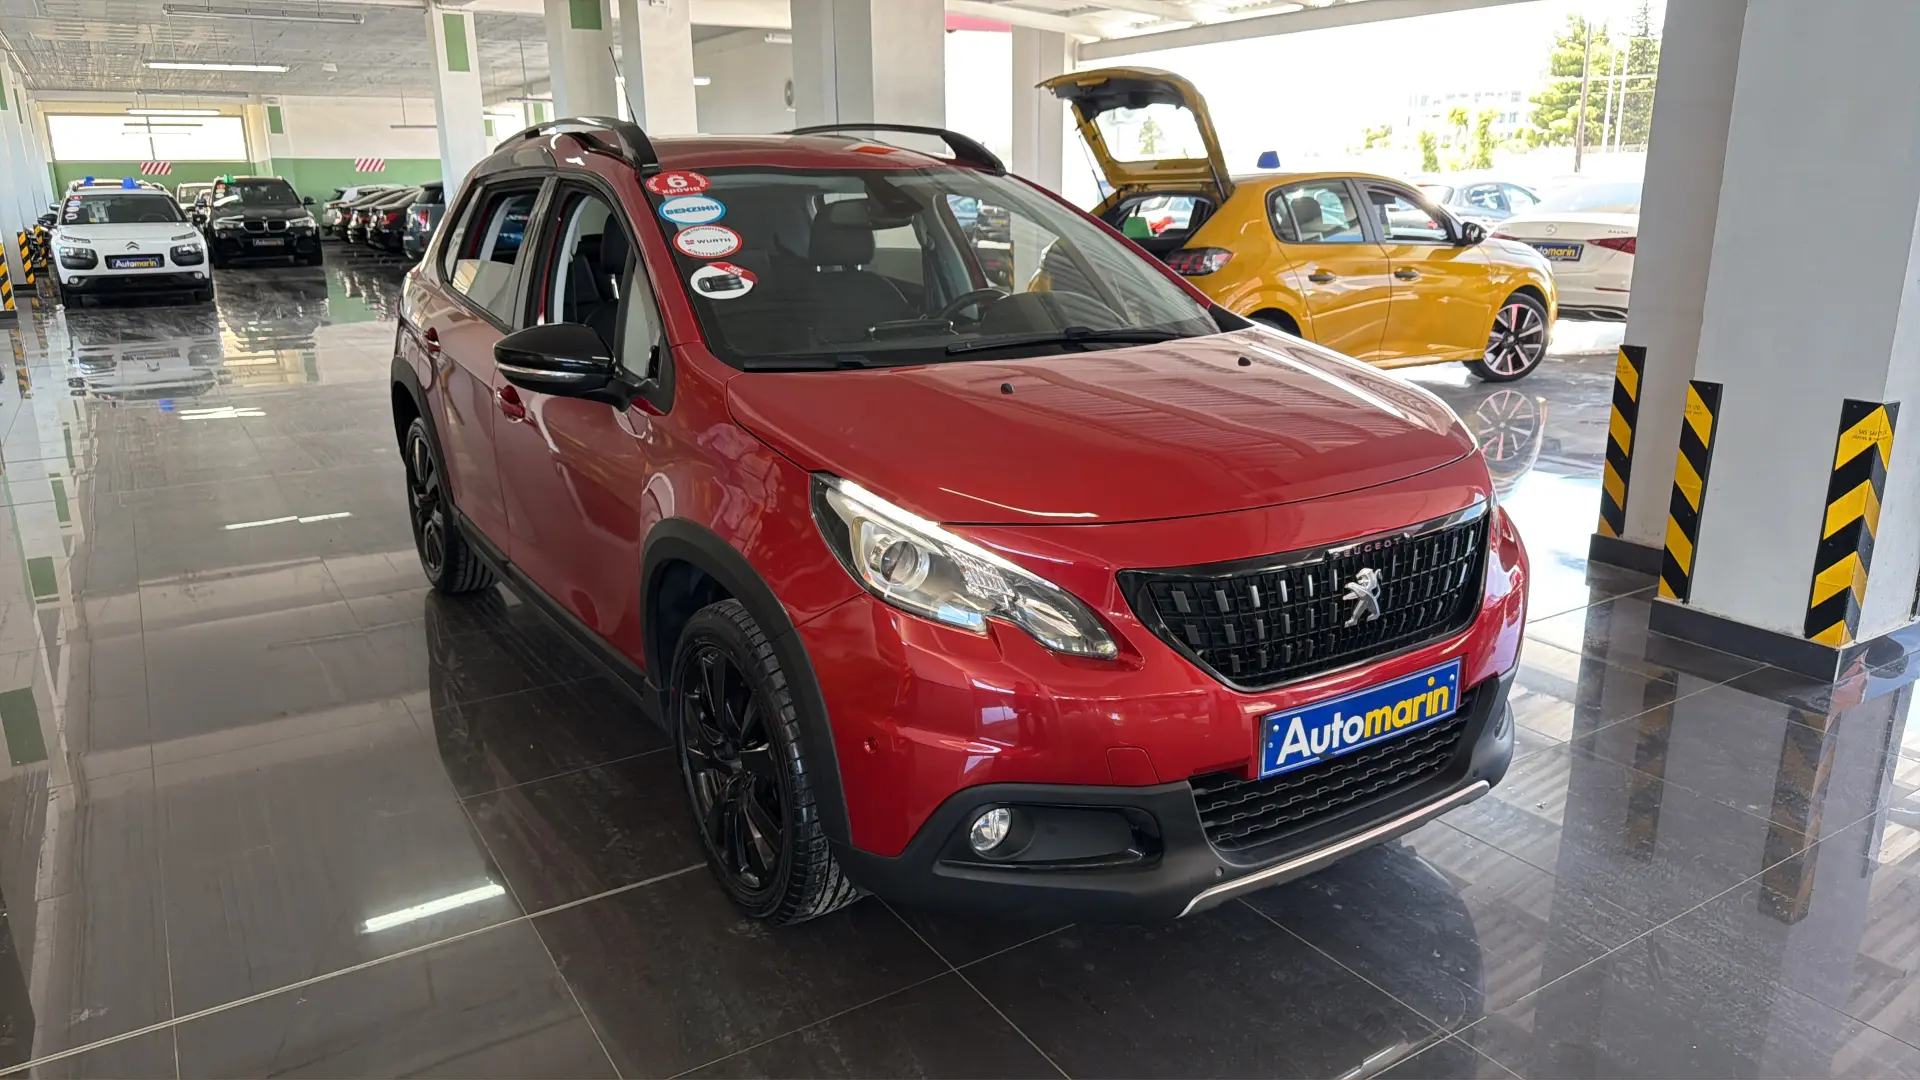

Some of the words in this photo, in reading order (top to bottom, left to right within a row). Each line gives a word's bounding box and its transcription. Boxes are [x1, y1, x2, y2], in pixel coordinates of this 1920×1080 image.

[667, 175, 688, 188] 6
[115, 259, 157, 268] Automarin
[1332, 538, 1401, 560] PEUGEOT
[1275, 676, 1450, 765] Automarin
